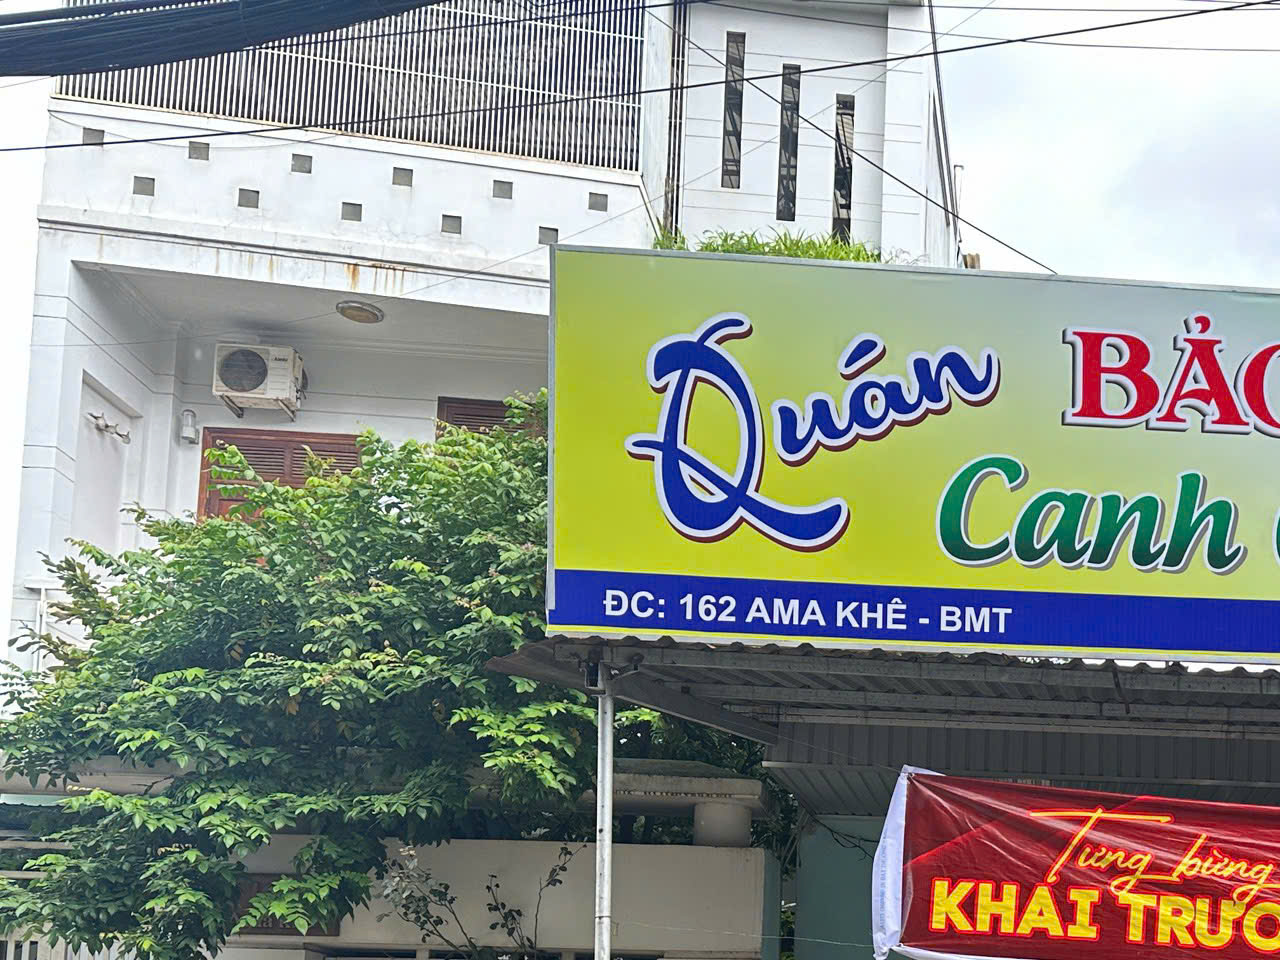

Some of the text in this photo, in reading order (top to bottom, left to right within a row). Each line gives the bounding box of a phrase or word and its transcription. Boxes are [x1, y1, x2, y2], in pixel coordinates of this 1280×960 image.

[625, 312, 1000, 551] Quán
[936, 454, 1248, 575] Canh
[603, 590, 665, 619] ĐC:
[679, 594, 736, 622] 162
[745, 597, 826, 627] AMA
[835, 598, 906, 631] KHÊ
[939, 606, 1013, 634] BMT
[1027, 807, 1179, 897] Tưng
[929, 876, 1101, 942] KHAI
